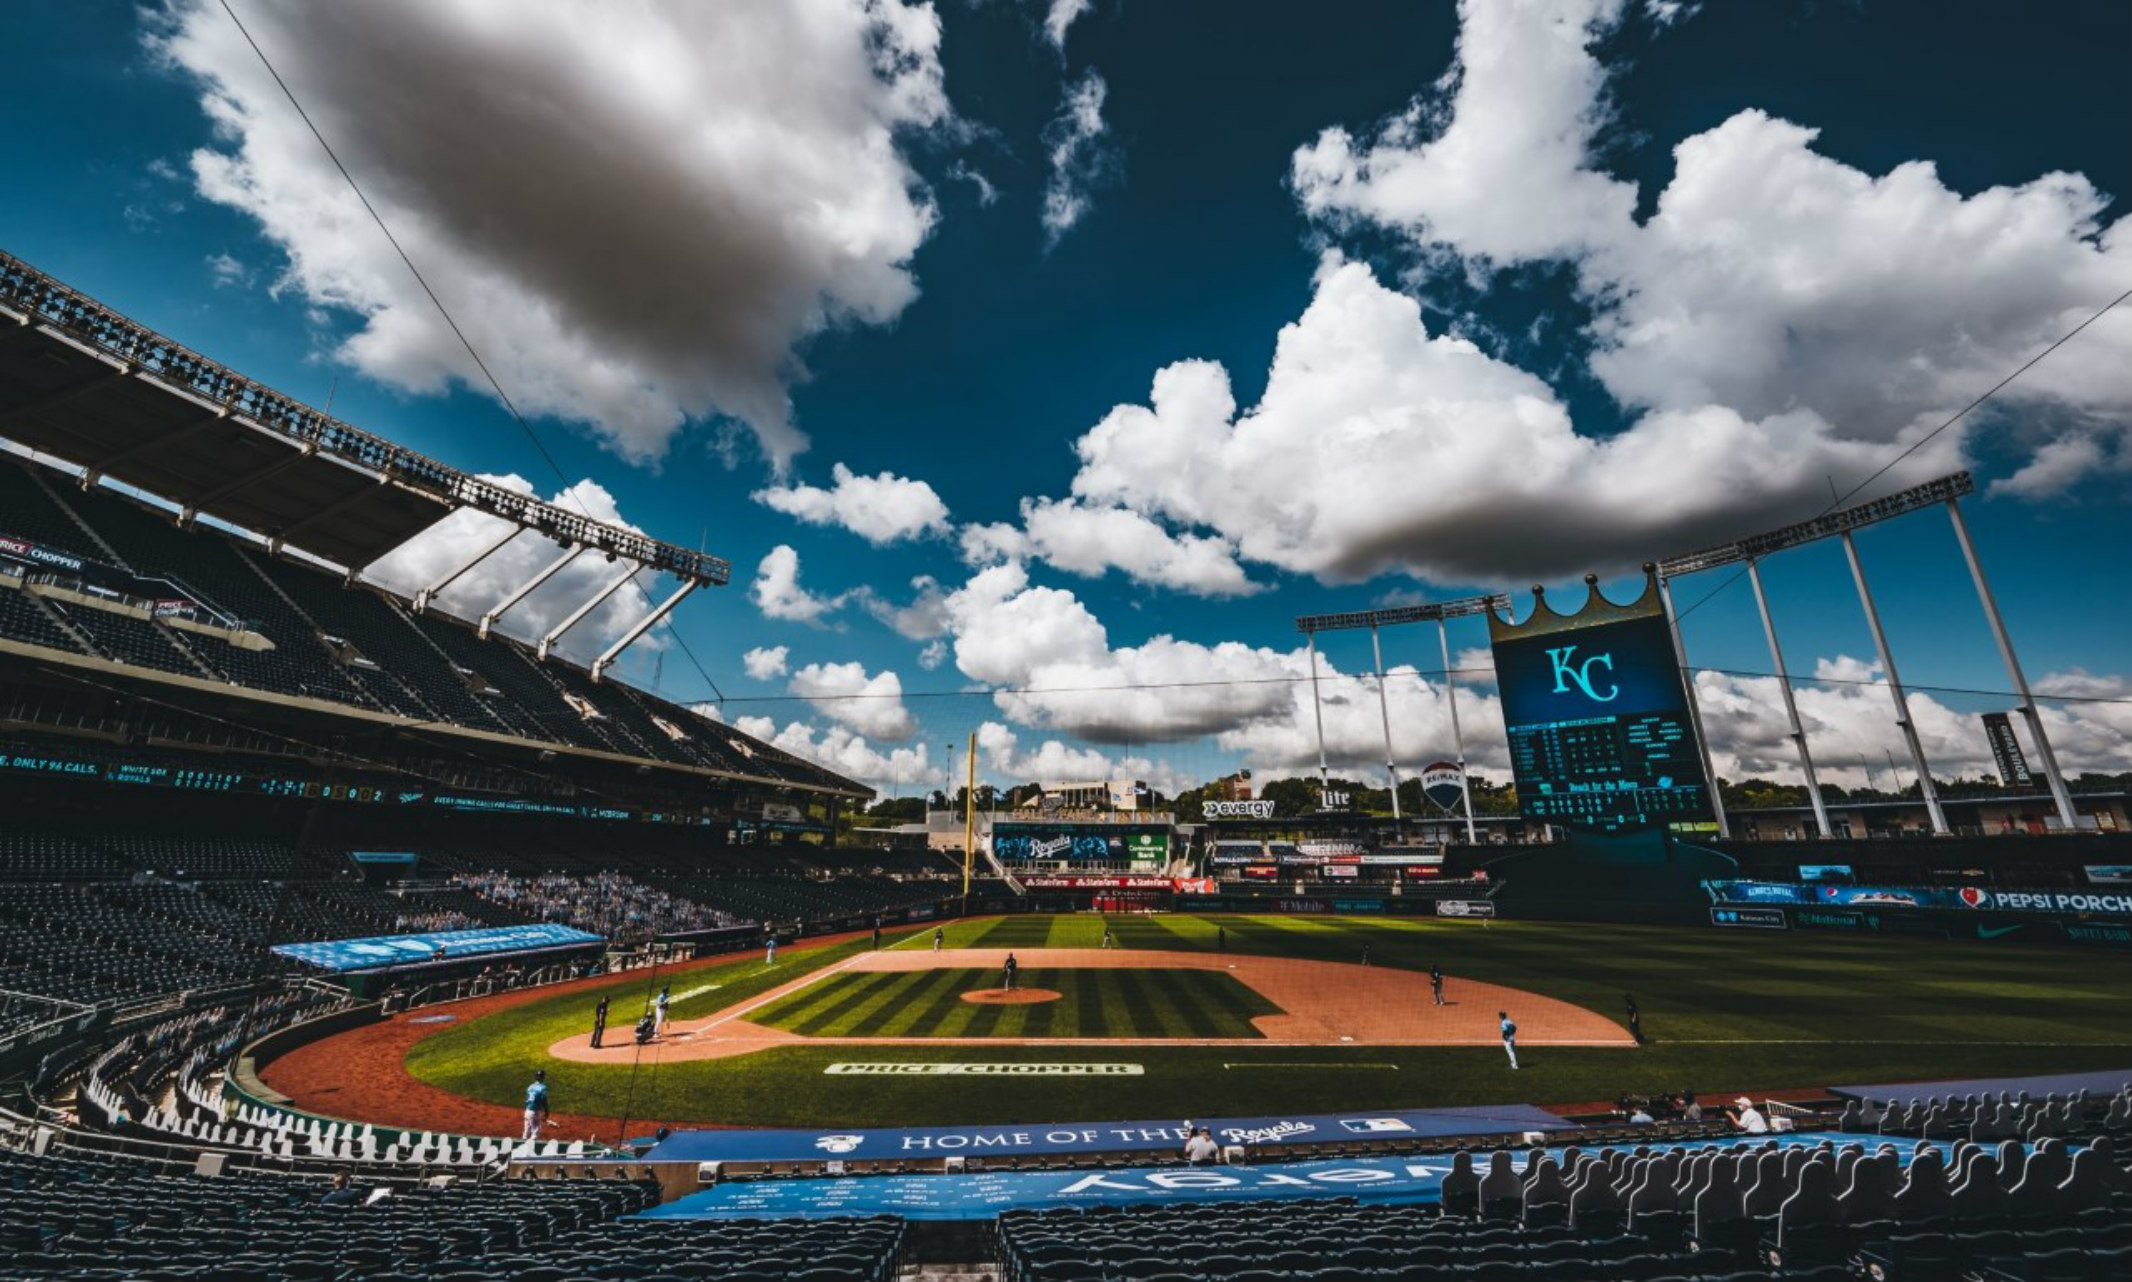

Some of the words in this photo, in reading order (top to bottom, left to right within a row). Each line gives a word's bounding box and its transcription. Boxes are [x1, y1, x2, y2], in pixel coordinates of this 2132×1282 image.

[31, 548, 82, 570] CHOPPER
[1544, 645, 1619, 702] KC
[13, 758, 46, 770] ONLY
[48, 761, 63, 771] 96
[64, 762, 98, 775] CALS.
[120, 765, 149, 774] WHITE
[117, 773, 152, 783] ROYALS
[1426, 773, 1460, 784] RE/MAX
[1321, 790, 1350, 809] Lite
[1220, 802, 1274, 818] evergy
[1029, 834, 1072, 858] Royals
[1995, 892, 2051, 909] PEPSI
[2056, 894, 2132, 912] PORCH
[1811, 914, 1857, 926] National
[841, 1065, 940, 1073] PRICE
[963, 1064, 1130, 1074] CHOPPER
[901, 1133, 1032, 1150] HOME
[1045, 1130, 1099, 1145] OF
[1110, 1126, 1191, 1143] THE
[1220, 1120, 1317, 1144] Royals
